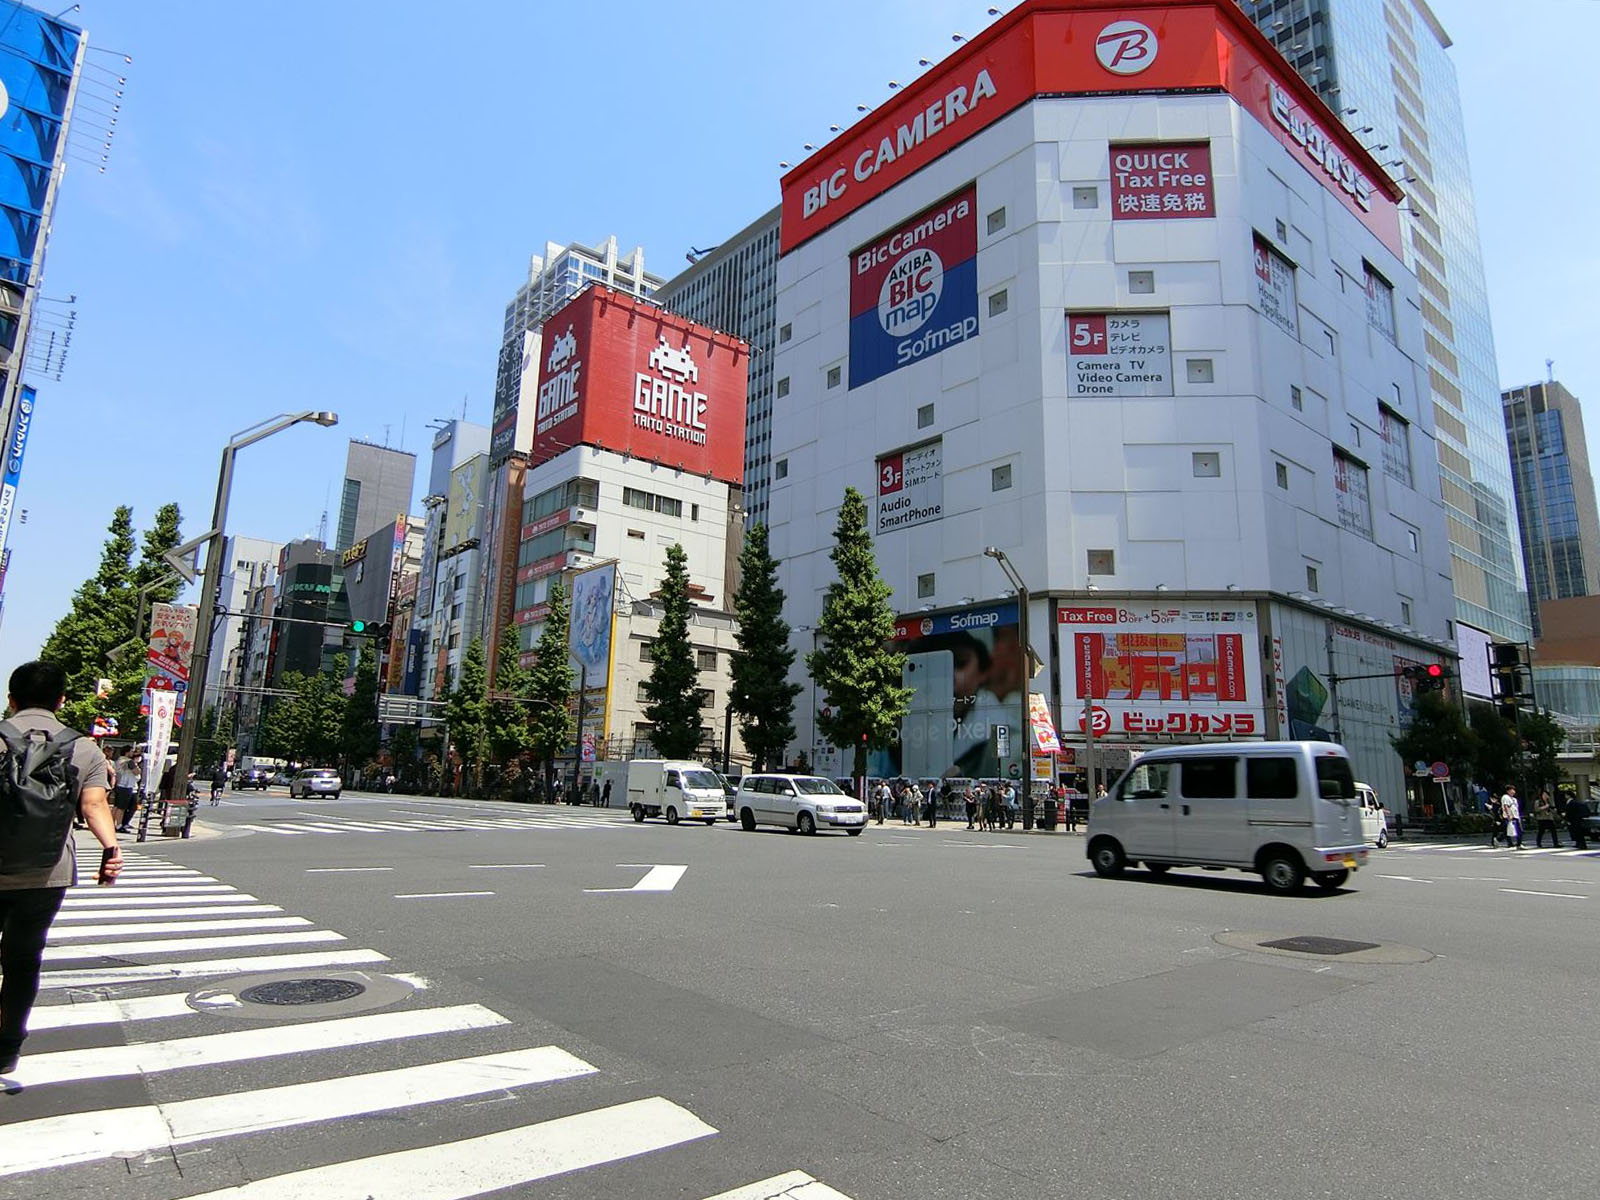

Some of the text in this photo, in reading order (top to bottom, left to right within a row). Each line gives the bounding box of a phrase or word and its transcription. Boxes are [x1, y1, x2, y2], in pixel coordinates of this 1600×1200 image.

[803, 69, 997, 219] BIC CAMERA
[1115, 152, 1189, 172] QUICK
[1115, 171, 1206, 188] Tax Free
[1117, 192, 1206, 213] 快速免税
[857, 200, 969, 275] BicCamera
[888, 251, 933, 284] AKIBA
[889, 266, 934, 309] BIC
[885, 292, 937, 331] map
[1073, 323, 1104, 347] 5F
[1110, 319, 1140, 329] カメラ
[897, 316, 977, 364] Sofmap
[1110, 332, 1141, 342] テレビ
[1110, 345, 1165, 355] ビデオカメラ
[1076, 360, 1145, 371] Camera TV
[1077, 372, 1163, 383] Video Camera
[538, 361, 582, 421] GAME
[1077, 384, 1114, 394] Drone
[633, 372, 708, 430] GAME
[633, 413, 706, 445] TAITO STATION
[904, 448, 936, 465] オーディオ
[881, 465, 902, 488] 3F
[904, 471, 941, 489] SIMカード
[880, 497, 911, 514] Audio
[880, 504, 941, 529] SmartPhone
[950, 612, 999, 629] Sofmap
[1061, 610, 1083, 622] Tax
[1086, 610, 1113, 622] Free
[1272, 636, 1287, 725] Tax Free
[946, 716, 991, 740] Pixel
[999, 727, 1007, 739] P
[1122, 711, 1255, 734] ビックカメラ
